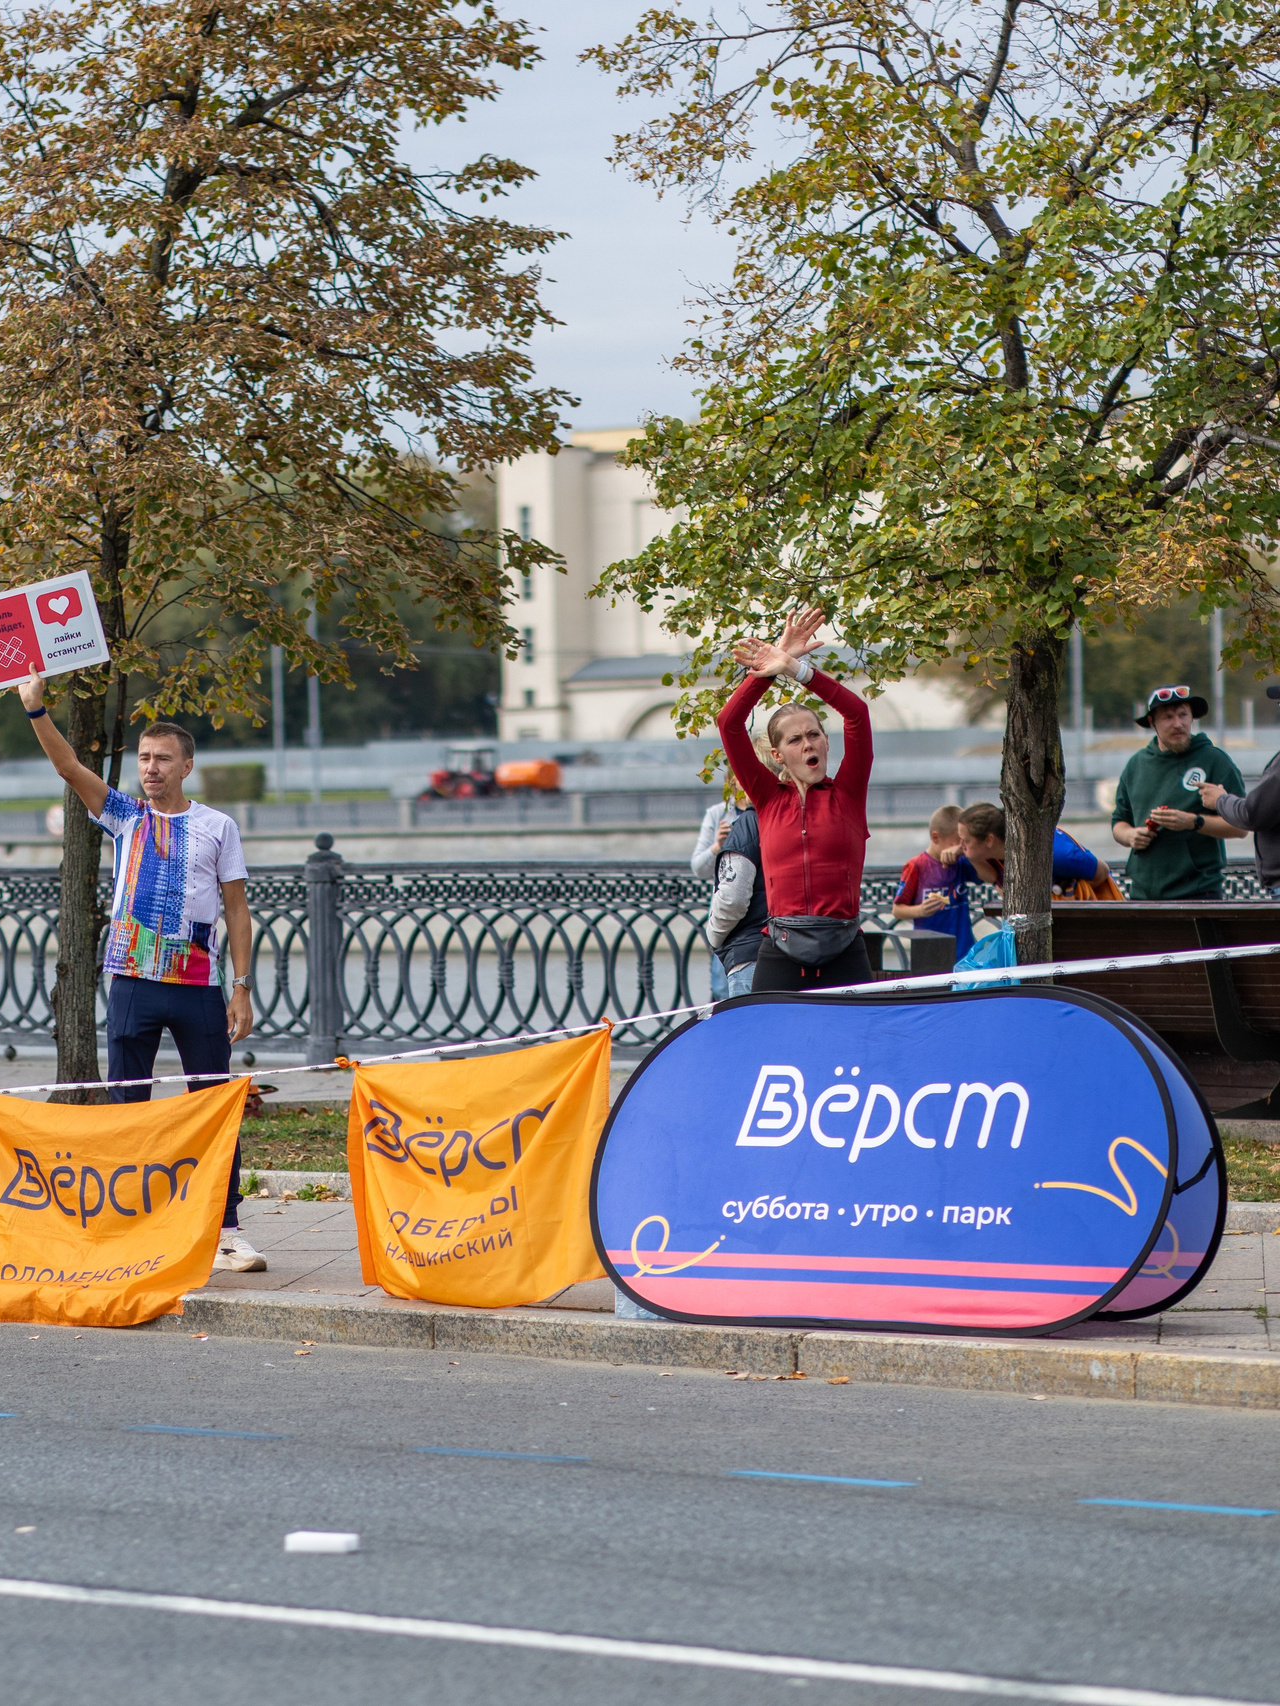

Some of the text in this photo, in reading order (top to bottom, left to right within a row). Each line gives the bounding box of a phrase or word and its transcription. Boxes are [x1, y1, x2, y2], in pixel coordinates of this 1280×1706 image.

[47, 640, 95, 659] останутся!
[54, 630, 82, 644] лайки
[735, 1065, 1030, 1164] Вёрст
[722, 1195, 1012, 1231] суббота утро парк
